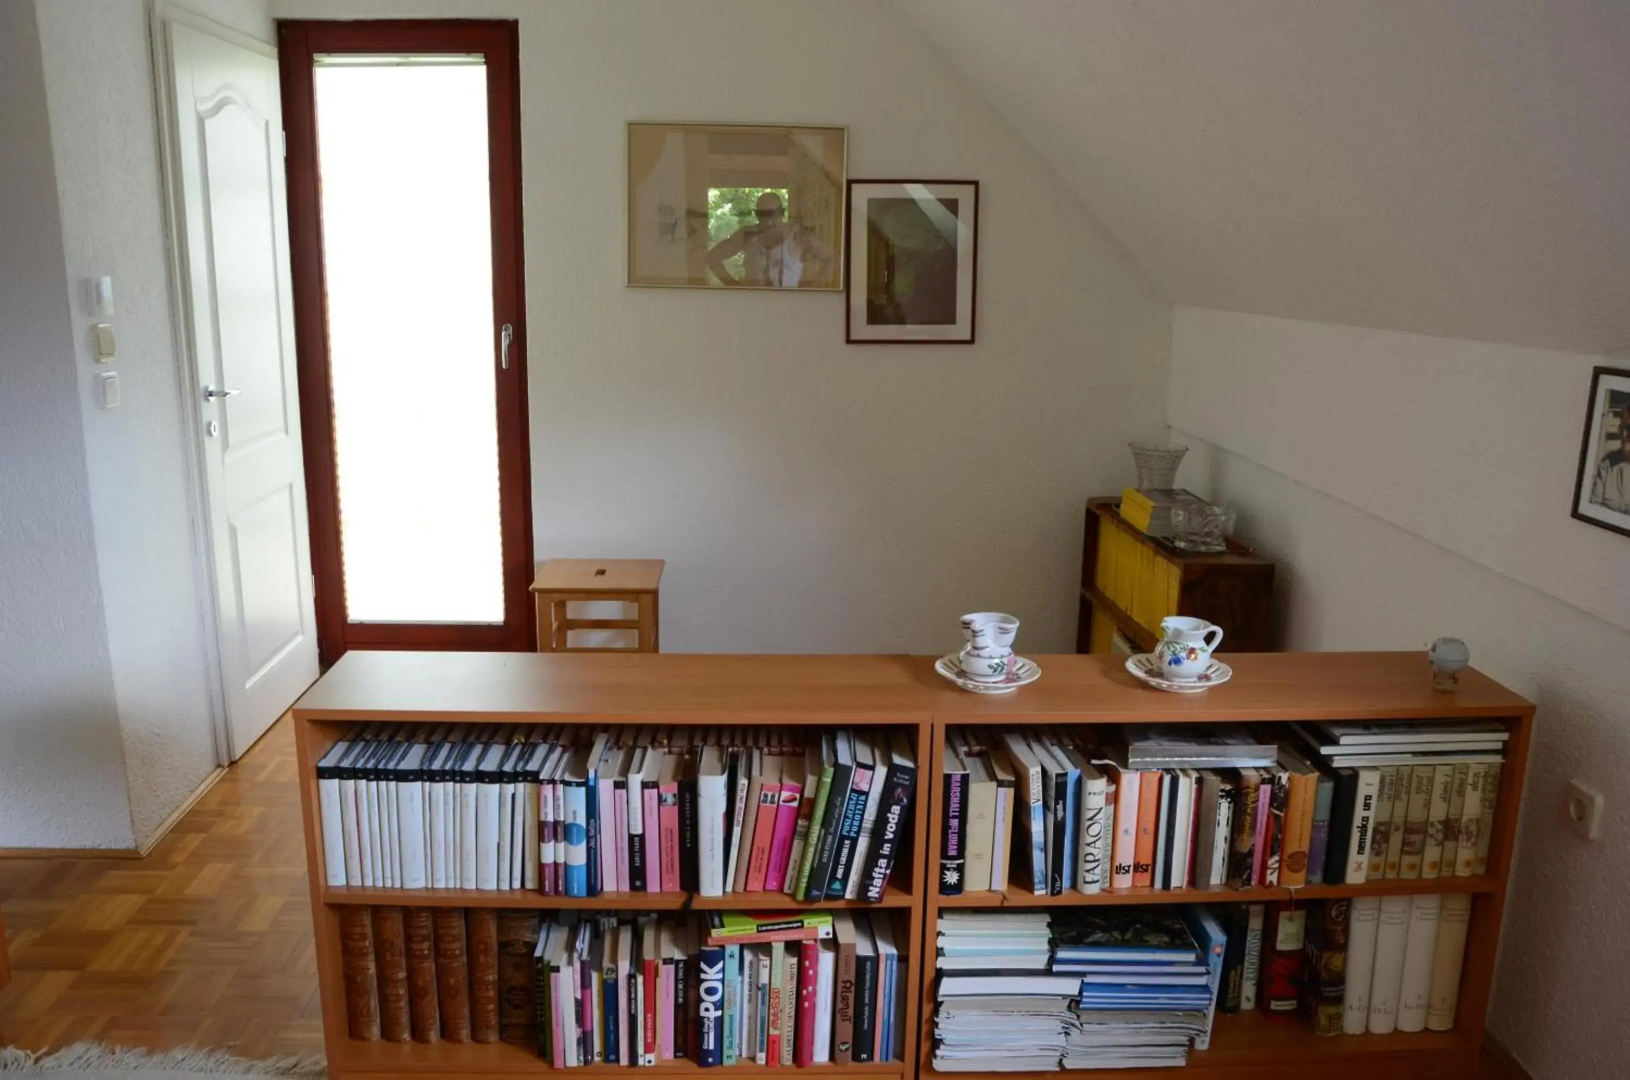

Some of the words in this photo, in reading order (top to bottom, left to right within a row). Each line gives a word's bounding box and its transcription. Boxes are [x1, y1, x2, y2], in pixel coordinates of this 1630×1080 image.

[849, 794, 866, 837] POROTNIK
[950, 773, 962, 817] MARSHALL
[884, 804, 902, 840] voda
[879, 842, 892, 857] in
[1082, 806, 1103, 885] FARAON
[867, 859, 889, 897] Nafta
[699, 960, 725, 1019] POK
